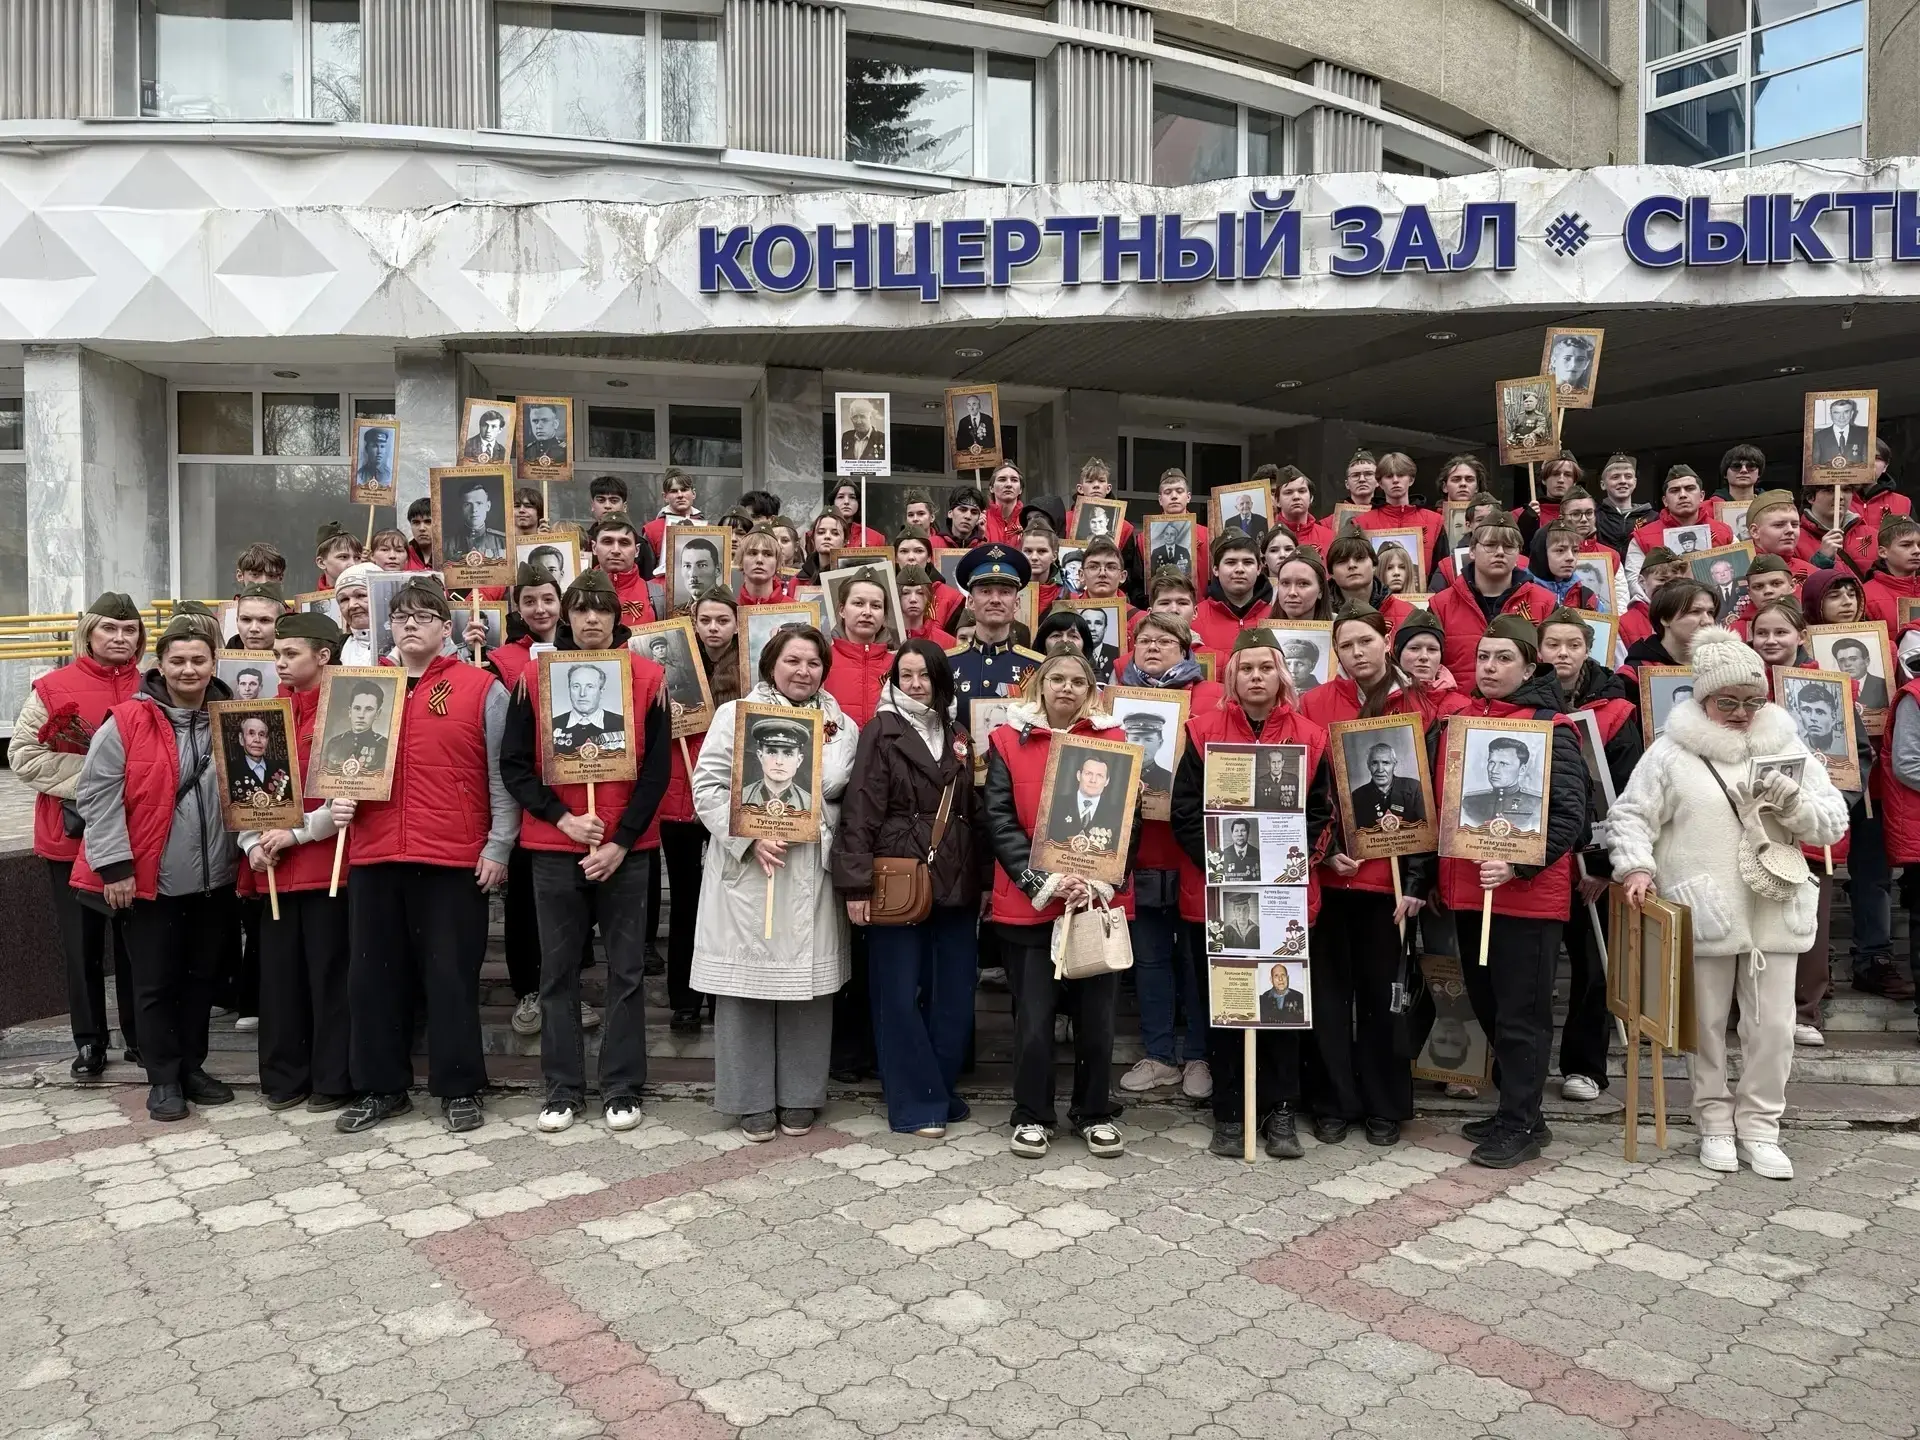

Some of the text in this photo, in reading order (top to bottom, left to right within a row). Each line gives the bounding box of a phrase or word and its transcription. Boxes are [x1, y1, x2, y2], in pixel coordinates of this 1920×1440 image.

[699, 189, 1302, 303] КОНЦЕРТНЫЙ
[1329, 202, 1517, 276] ЗАЛ
[756, 818, 794, 826] Туголуков
[1370, 833, 1416, 844] Покровский
[1478, 838, 1517, 848] Тимушев
